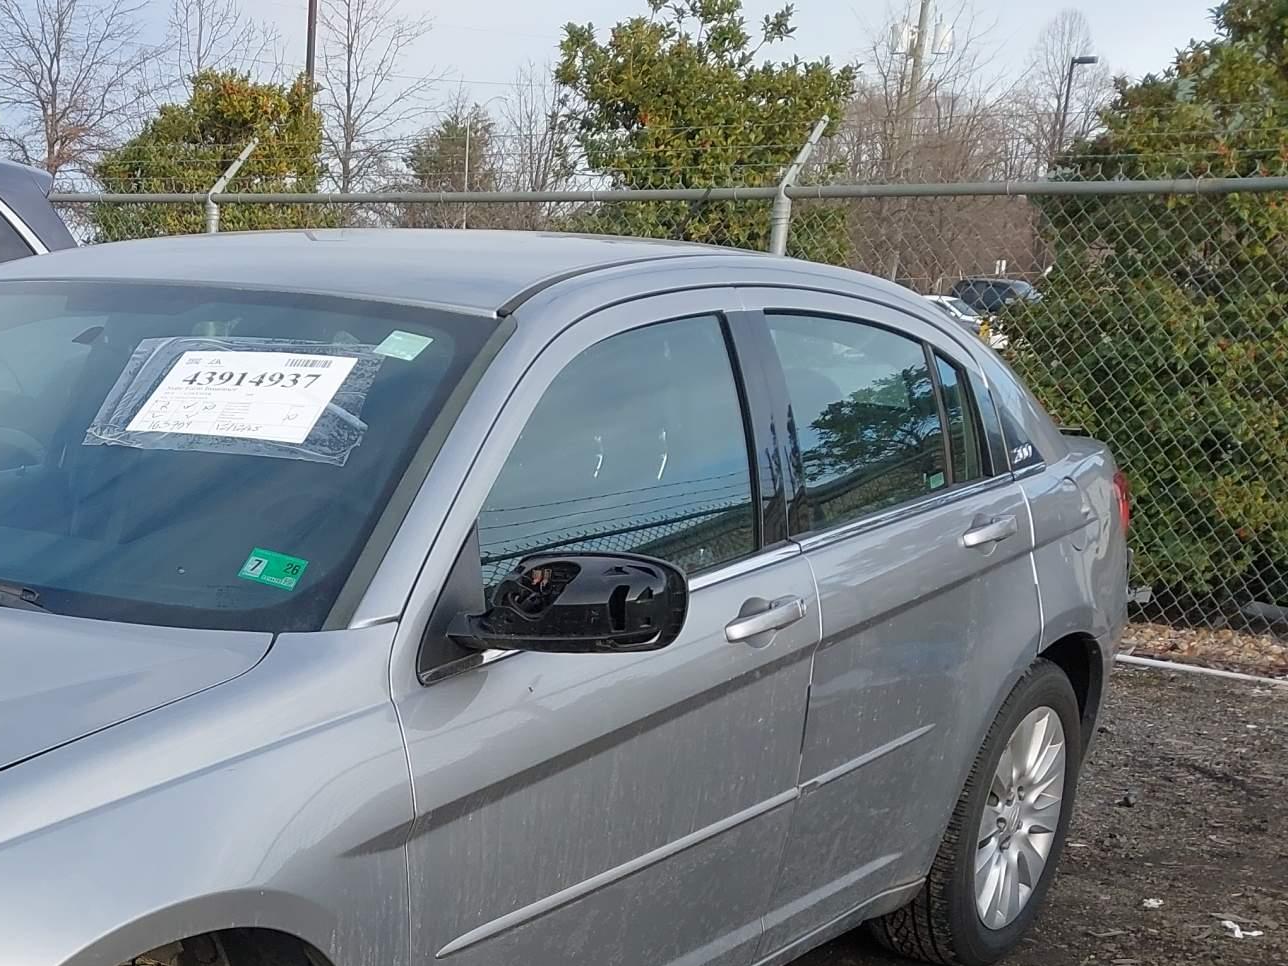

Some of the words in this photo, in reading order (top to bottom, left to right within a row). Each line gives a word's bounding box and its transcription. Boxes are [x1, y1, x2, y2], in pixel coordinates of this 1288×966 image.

[182, 370, 321, 389] 43914937
[250, 559, 263, 572] 7
[283, 563, 301, 575] 26
